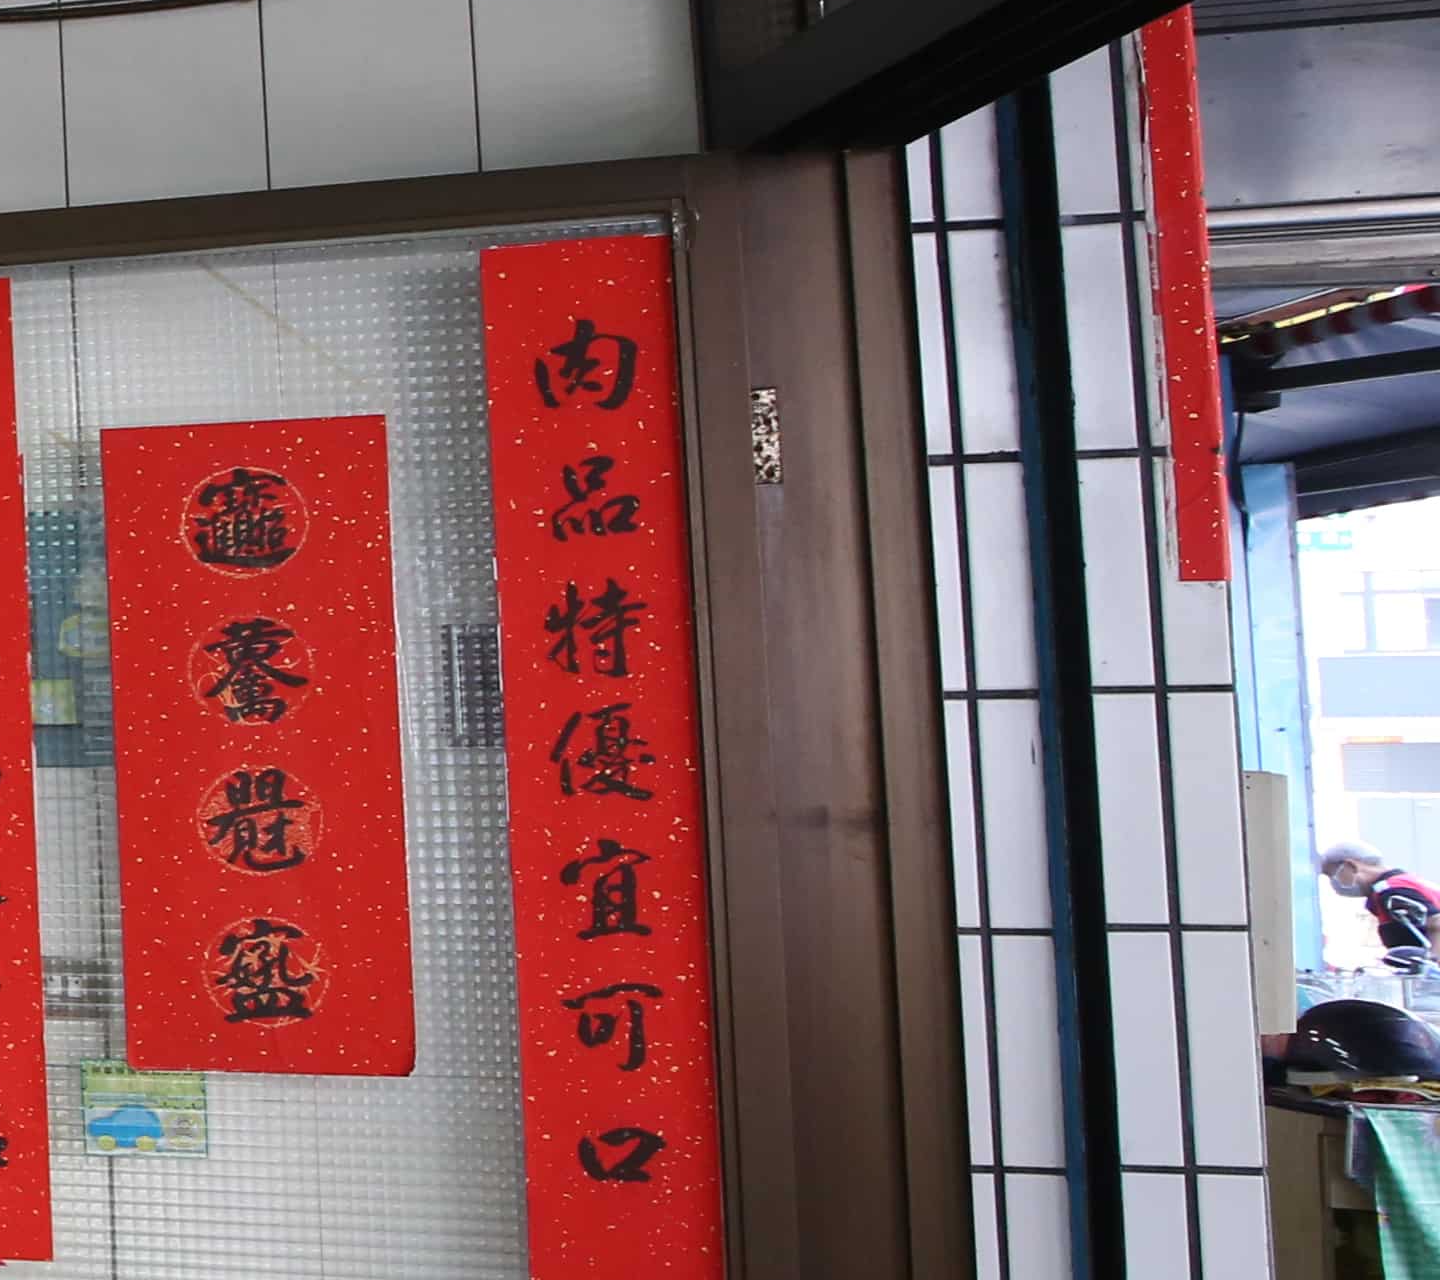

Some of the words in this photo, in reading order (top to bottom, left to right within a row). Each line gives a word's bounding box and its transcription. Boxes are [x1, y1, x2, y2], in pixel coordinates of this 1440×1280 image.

[534, 318, 664, 1184] 肉品特優宜可口
